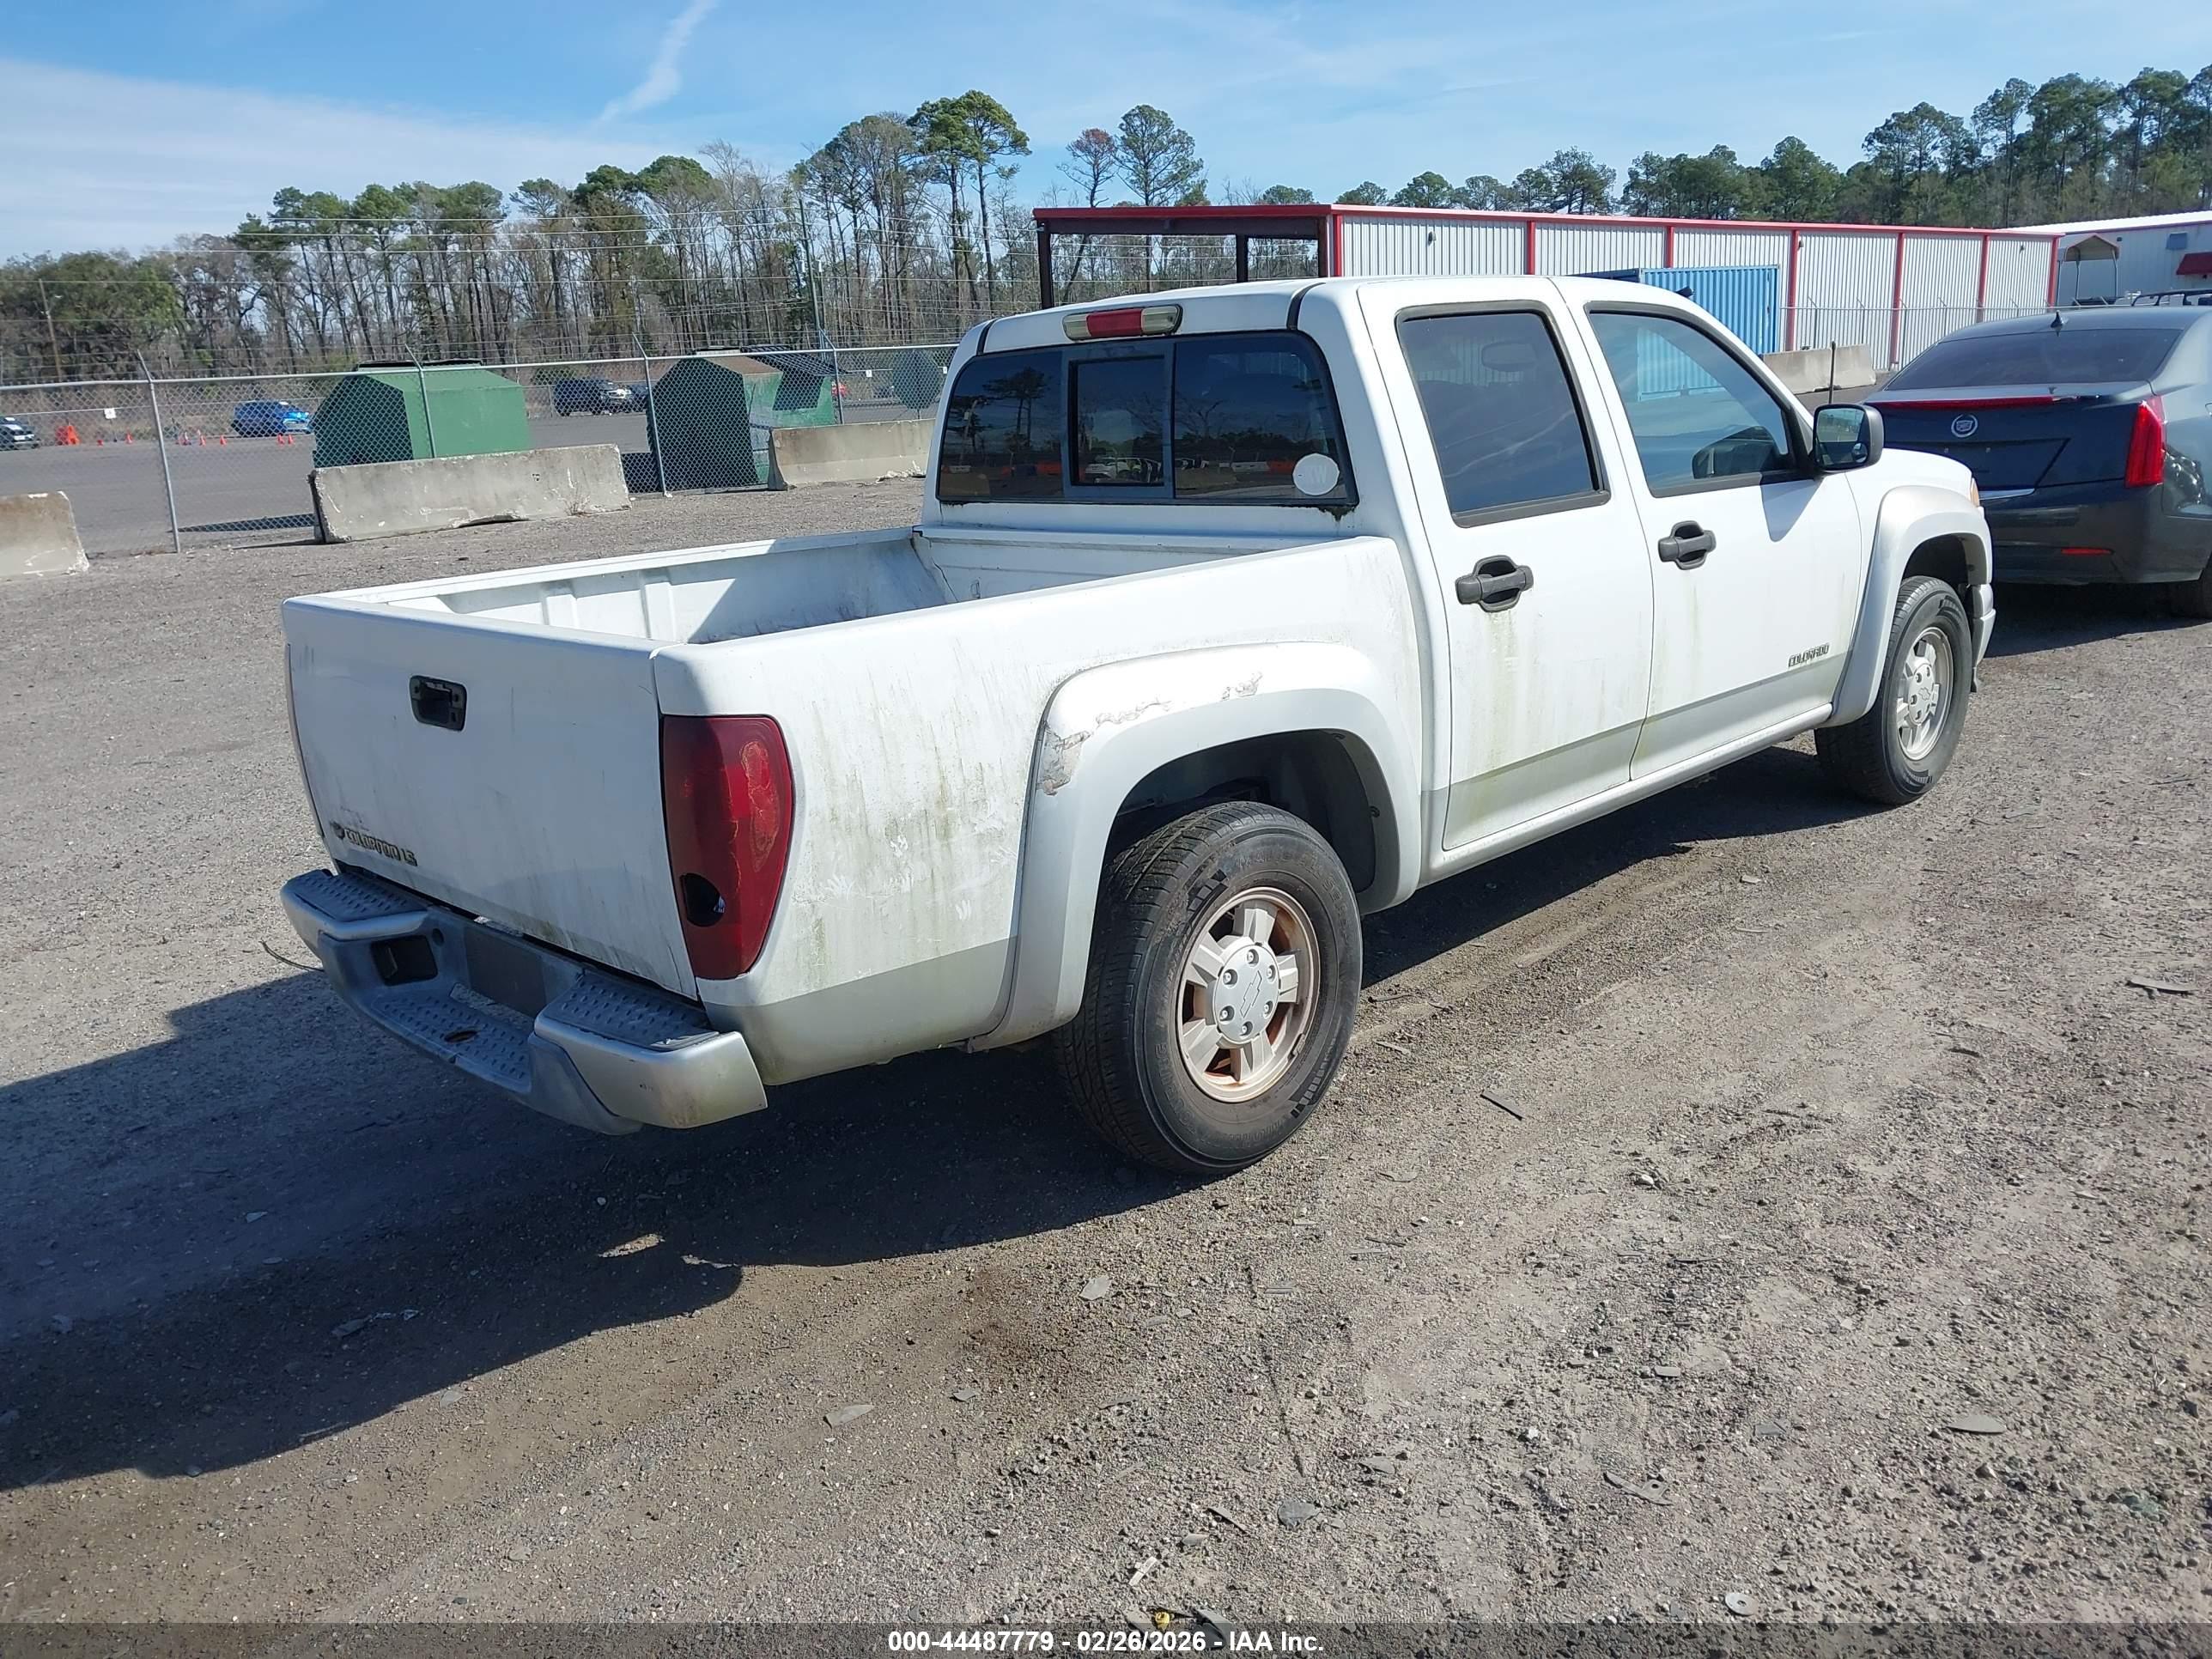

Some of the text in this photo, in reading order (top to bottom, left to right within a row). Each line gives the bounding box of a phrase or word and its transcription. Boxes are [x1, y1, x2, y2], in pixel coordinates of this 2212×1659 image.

[1788, 642, 1831, 668] COLORADO
[344, 827, 418, 866] COLORADO LS
